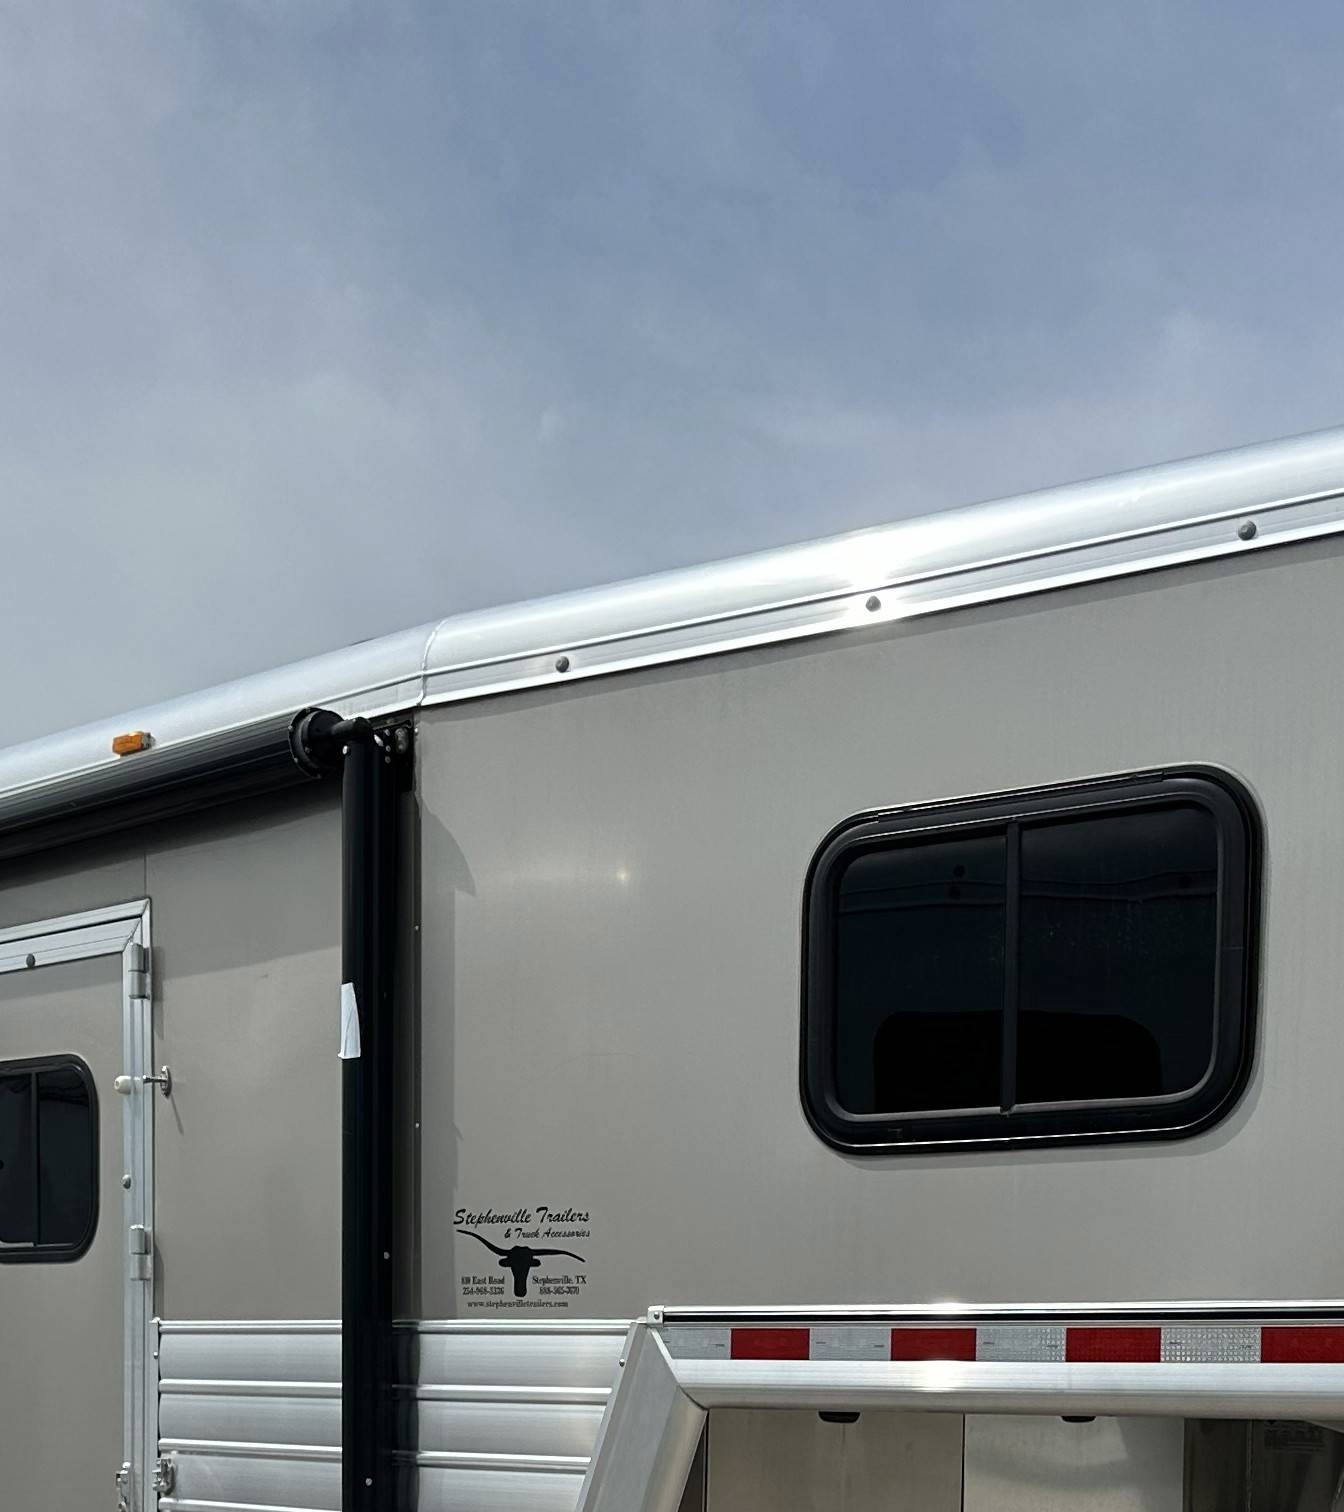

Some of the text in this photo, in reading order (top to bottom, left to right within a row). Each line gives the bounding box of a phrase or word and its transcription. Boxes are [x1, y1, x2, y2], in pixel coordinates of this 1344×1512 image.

[453, 1206, 591, 1228] Stephenville Trailers
[504, 1227, 591, 1239] & Truck Accessories
[575, 1275, 587, 1284] TX
